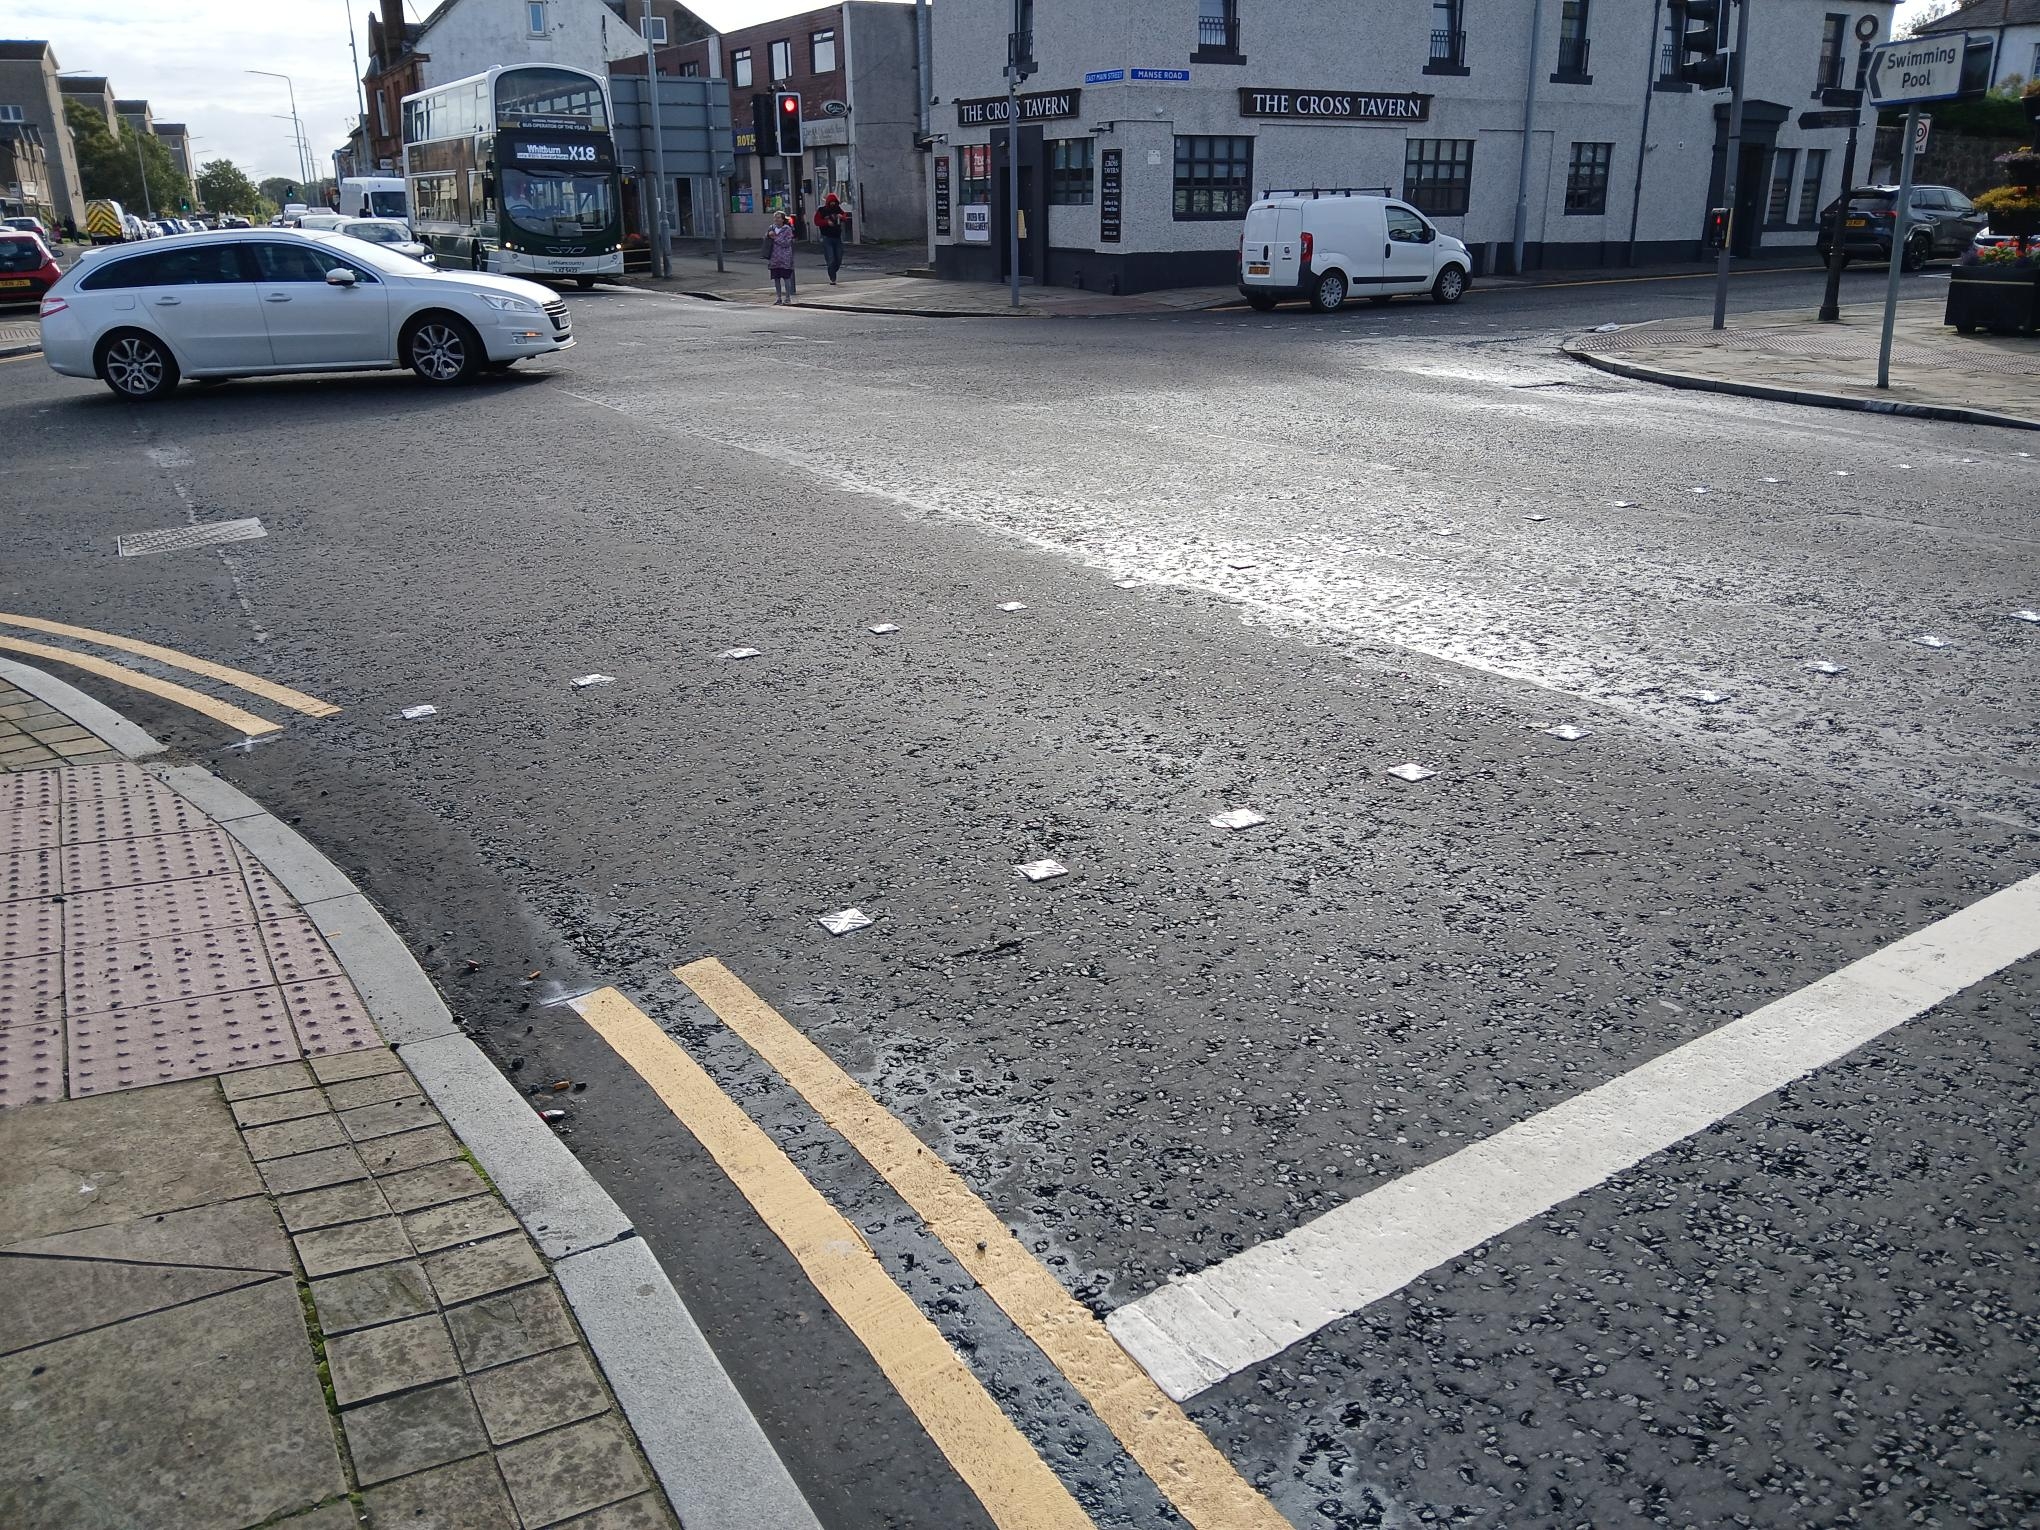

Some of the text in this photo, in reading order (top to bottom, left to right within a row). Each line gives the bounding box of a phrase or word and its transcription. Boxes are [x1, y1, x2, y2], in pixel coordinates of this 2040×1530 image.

[1887, 47, 1956, 70] Swimming
[1097, 73, 1107, 81] MAIN
[1107, 71, 1123, 80] STREET
[1137, 71, 1183, 80] MANSE ROAD
[1902, 69, 1931, 88] Pool
[962, 95, 1070, 122] THE CROS TAVERN
[1252, 94, 1421, 117] THE CROSS TAVERN
[526, 144, 562, 154] Whitburn
[568, 145, 596, 161] X18
